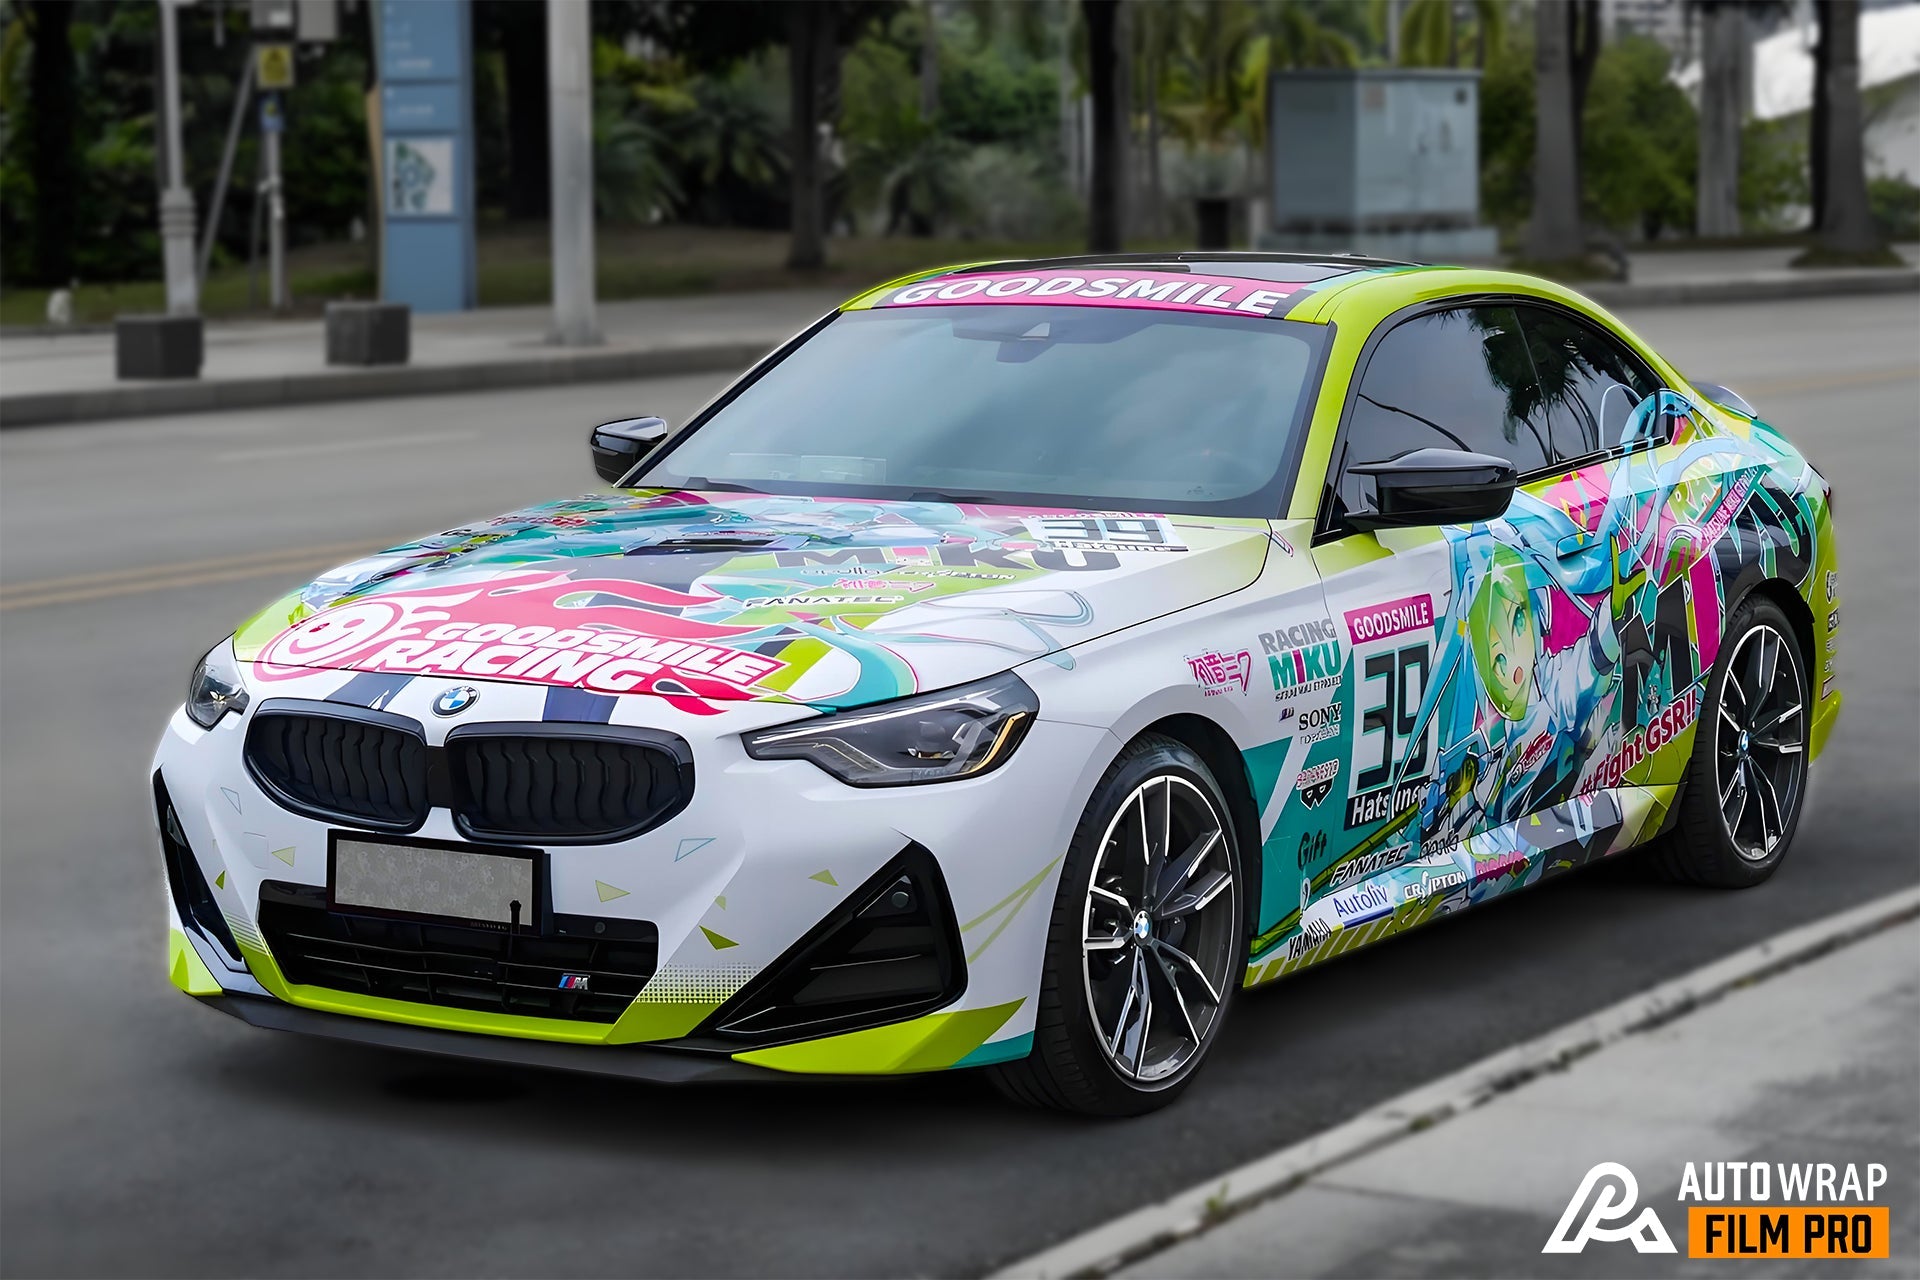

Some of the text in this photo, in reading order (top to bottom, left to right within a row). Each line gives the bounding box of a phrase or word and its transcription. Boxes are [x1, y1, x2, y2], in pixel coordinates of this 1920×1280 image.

[893, 276, 1291, 315] GOODSMILE
[746, 596, 897, 608] FANATEC
[1353, 601, 1430, 640] GOODSMILE
[424, 622, 779, 685] GOODSMILE
[1258, 618, 1337, 655] RACING
[372, 640, 656, 692] RACING
[1266, 640, 1342, 691] MIKU
[1299, 703, 1341, 731] SONY
[1356, 641, 1430, 792] 39
[1645, 688, 1697, 754] GSR!!
[1297, 829, 1328, 870] Gift
[1331, 846, 1410, 885] FANATEC
[1333, 882, 1389, 917] Autoliv
[1288, 918, 1332, 960] YAMAHA
